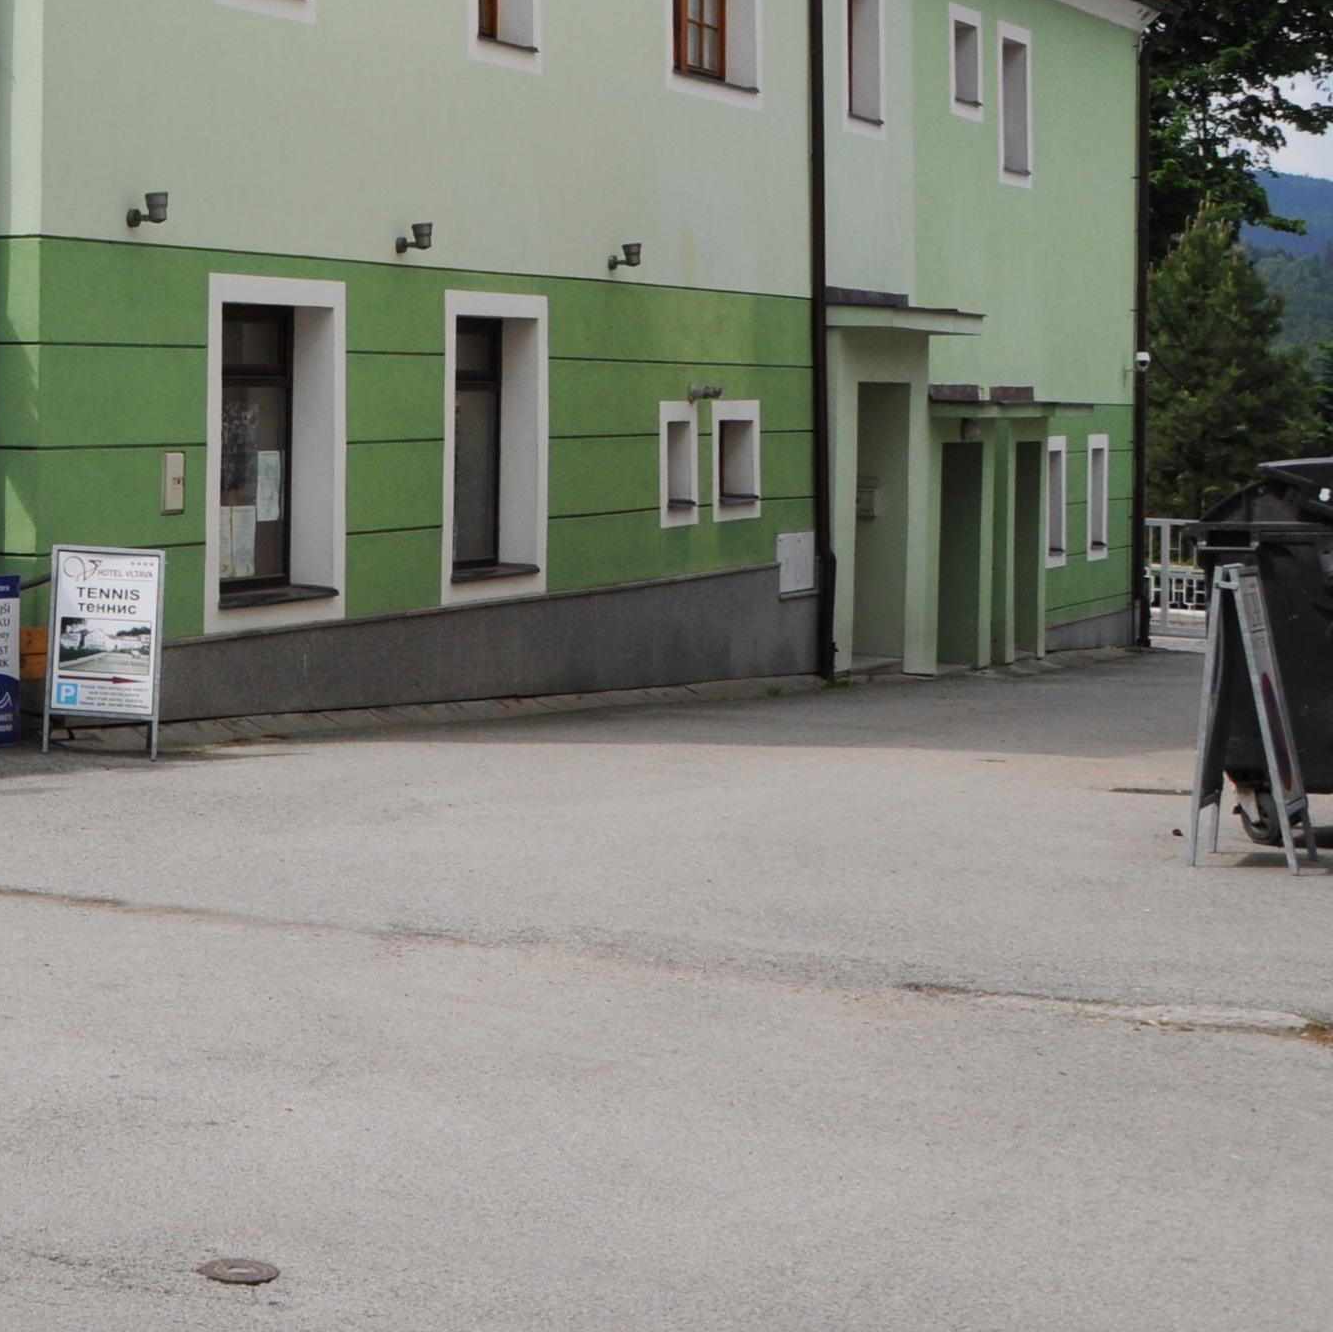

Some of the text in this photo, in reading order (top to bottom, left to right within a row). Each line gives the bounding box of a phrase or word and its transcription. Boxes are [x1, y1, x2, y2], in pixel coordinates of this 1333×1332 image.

[97, 569, 153, 579] HOTEL VLTAVA
[77, 586, 141, 602] TENNIS
[78, 602, 137, 615] теннис
[61, 684, 76, 702] P
